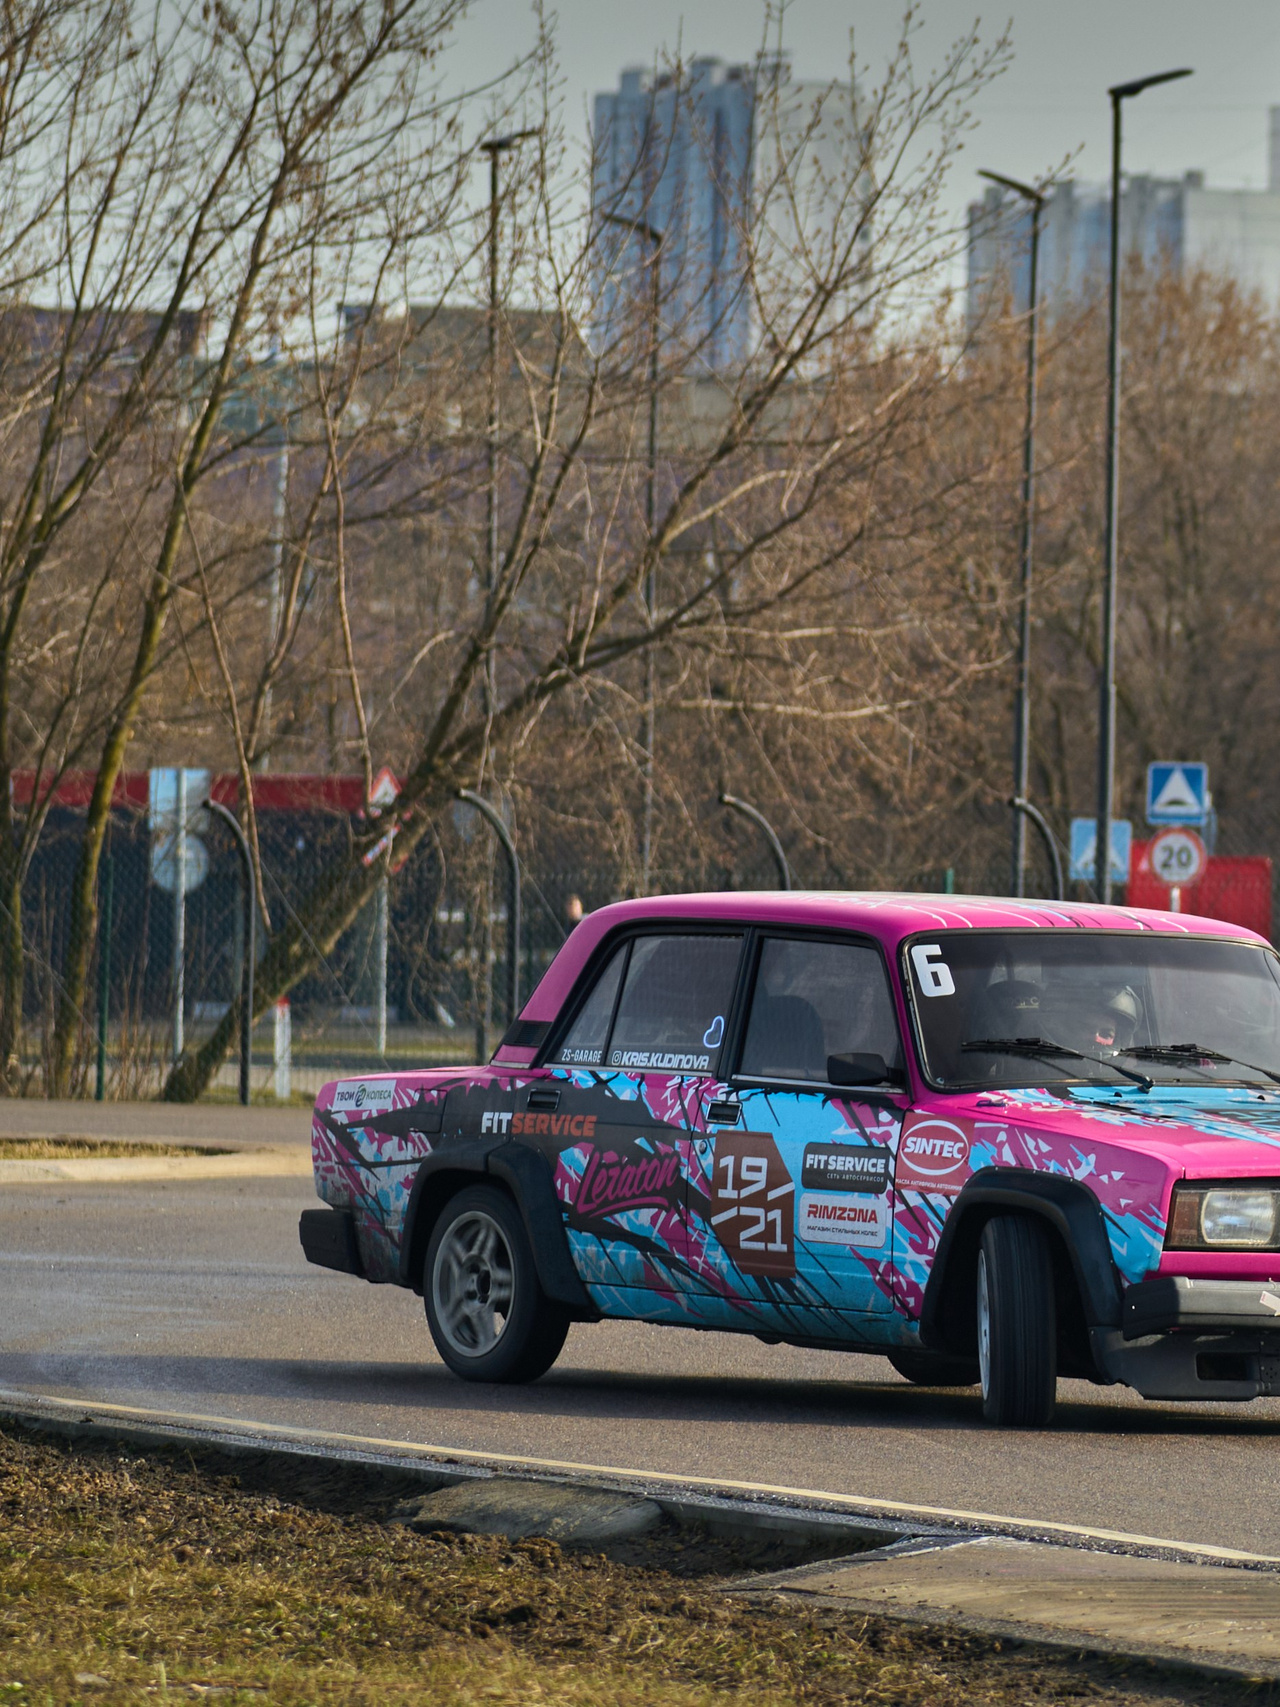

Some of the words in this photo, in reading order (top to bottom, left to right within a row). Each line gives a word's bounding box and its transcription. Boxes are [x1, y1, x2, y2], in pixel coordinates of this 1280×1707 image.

[1161, 845, 1192, 868] 20
[911, 944, 956, 997] 6
[561, 1049, 602, 1063] ZS-GARAGE
[336, 1092, 354, 1101] ТВОИ
[365, 1090, 392, 1101] КОЛЕСА
[904, 1136, 964, 1159] SINTEC
[826, 1172, 840, 1180] СЕТЬ
[842, 1174, 885, 1183] АВТОСЕРВИСОВ
[807, 1204, 878, 1224] RIMZONA
[832, 1227, 860, 1235] СТИЛЬНЫХ
